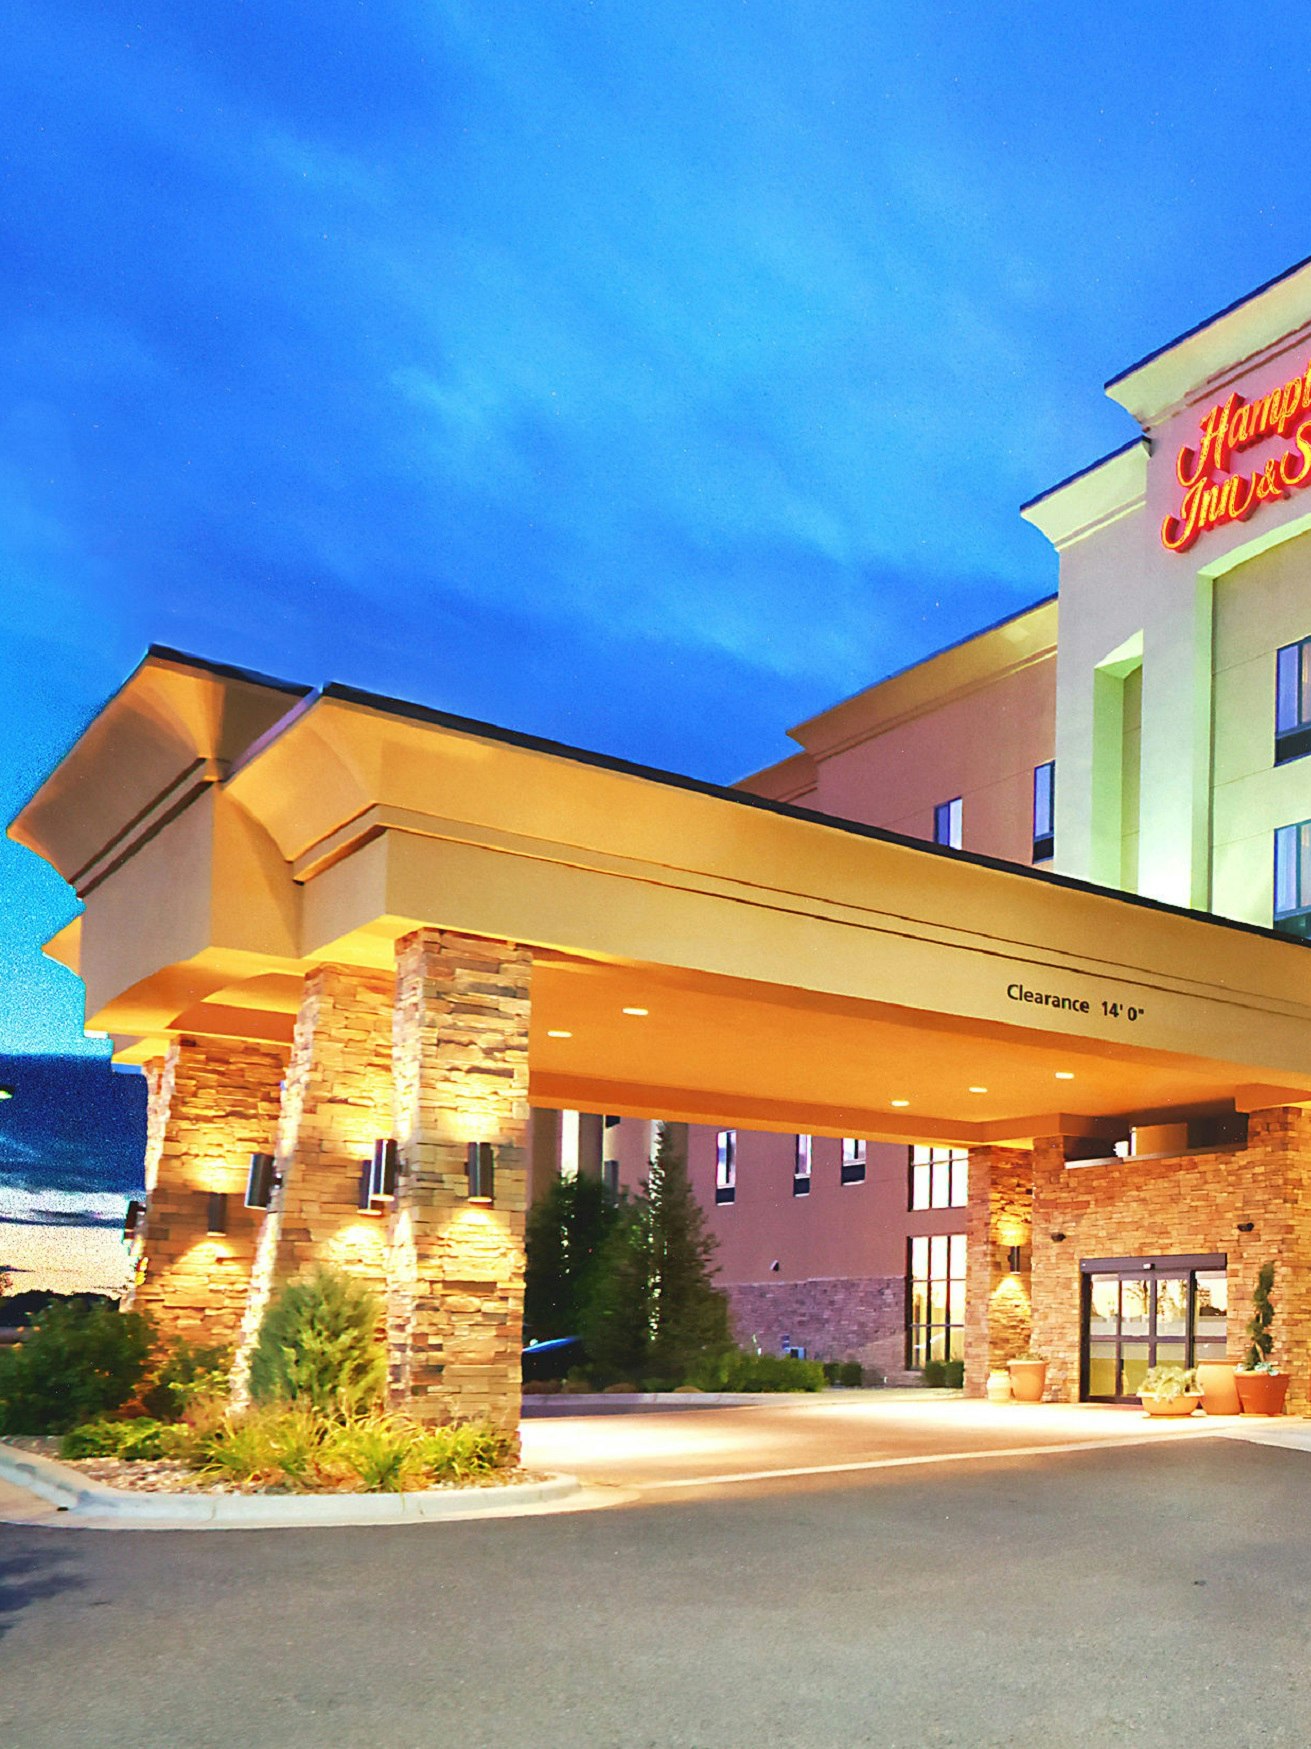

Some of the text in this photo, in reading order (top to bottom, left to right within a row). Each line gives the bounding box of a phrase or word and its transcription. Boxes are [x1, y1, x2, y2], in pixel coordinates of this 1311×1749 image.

[1161, 471, 1259, 553] Inn
[1255, 458, 1290, 501] &
[1007, 983, 1090, 1013] Clearance
[1102, 1001, 1123, 1018] 14'
